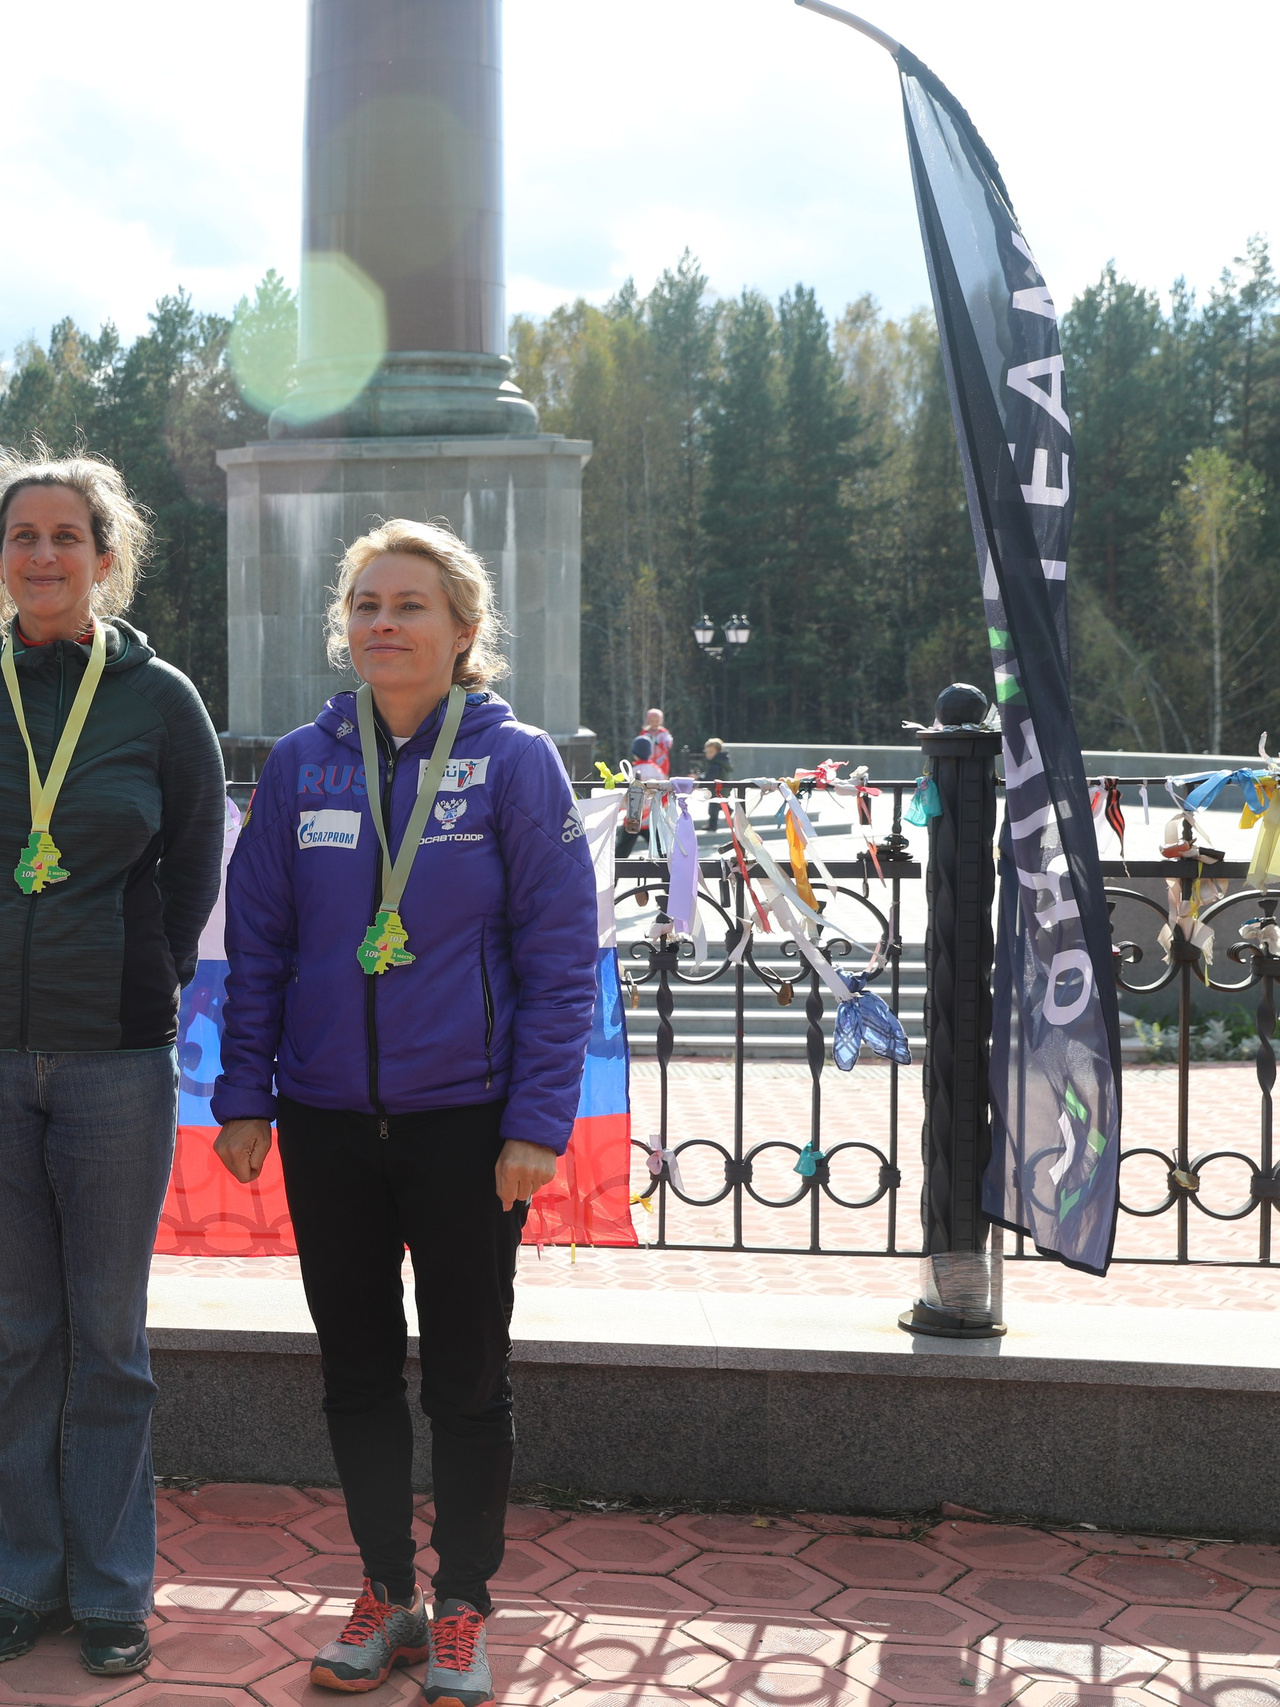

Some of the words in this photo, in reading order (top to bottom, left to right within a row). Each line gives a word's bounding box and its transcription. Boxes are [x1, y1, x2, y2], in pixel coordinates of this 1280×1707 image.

[336, 727, 353, 740] adid
[312, 831, 355, 845] GAZPROM
[419, 833, 484, 845] ОСАВТОДОР
[561, 822, 586, 843] adi
